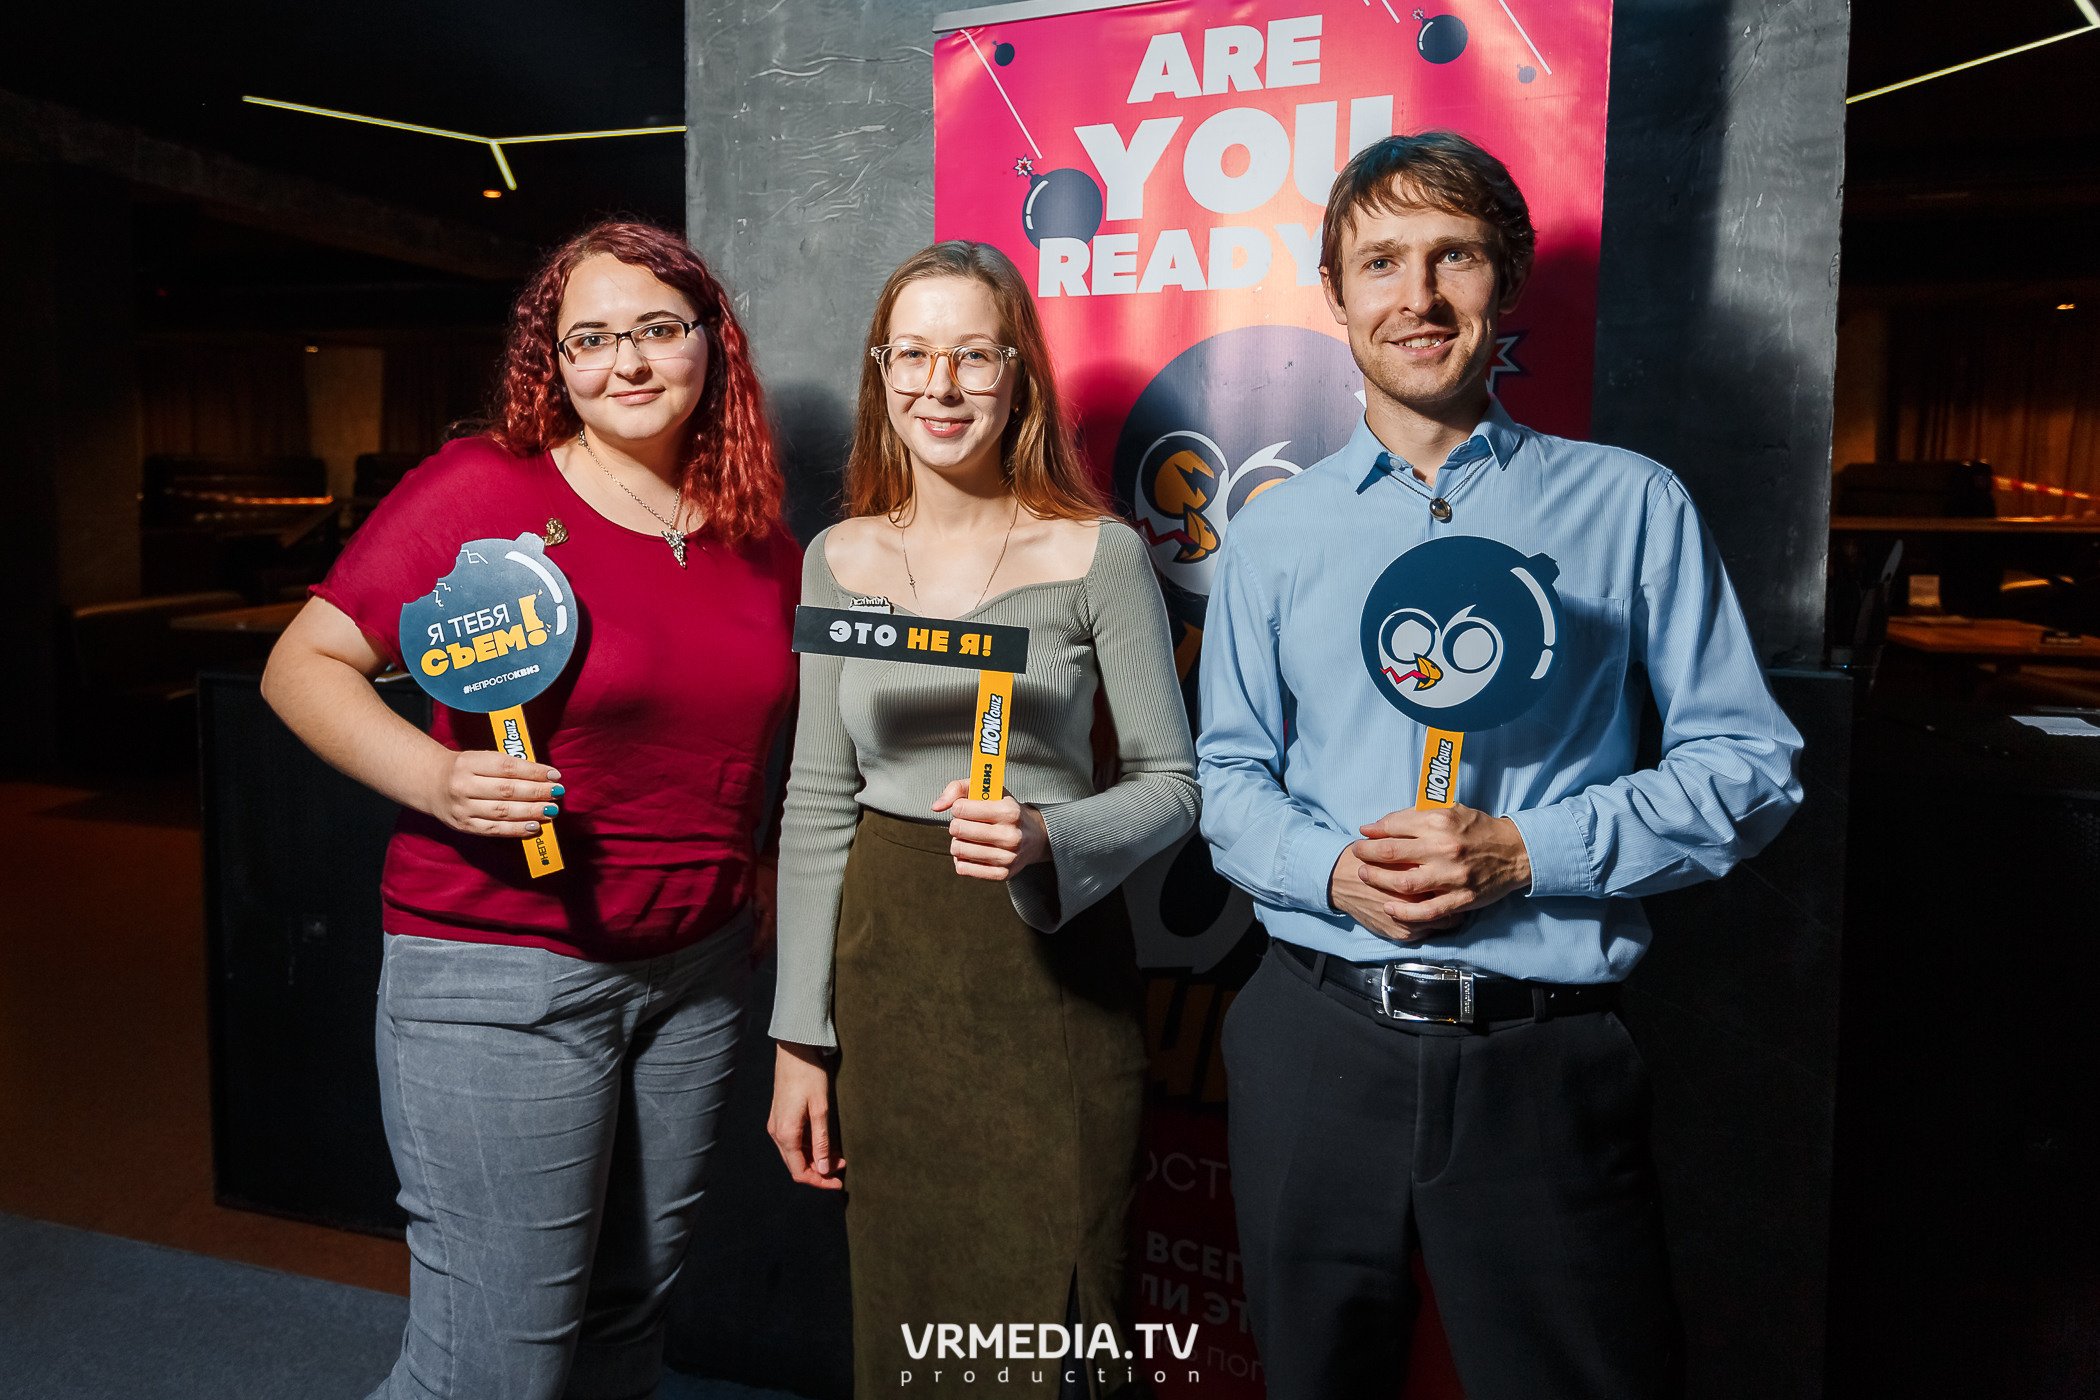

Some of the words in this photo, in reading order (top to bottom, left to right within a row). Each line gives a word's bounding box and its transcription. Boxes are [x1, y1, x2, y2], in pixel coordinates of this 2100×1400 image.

[1126, 15, 1322, 103] ARE
[1073, 94, 1394, 222] YOU
[426, 622, 445, 646] Я
[447, 603, 510, 638] ТЕБЯ
[829, 620, 897, 647] ЭТО
[907, 627, 950, 653] НЕ
[958, 633, 993, 657] Я!
[462, 664, 540, 694] #НЕПРОСТОКВИЗ
